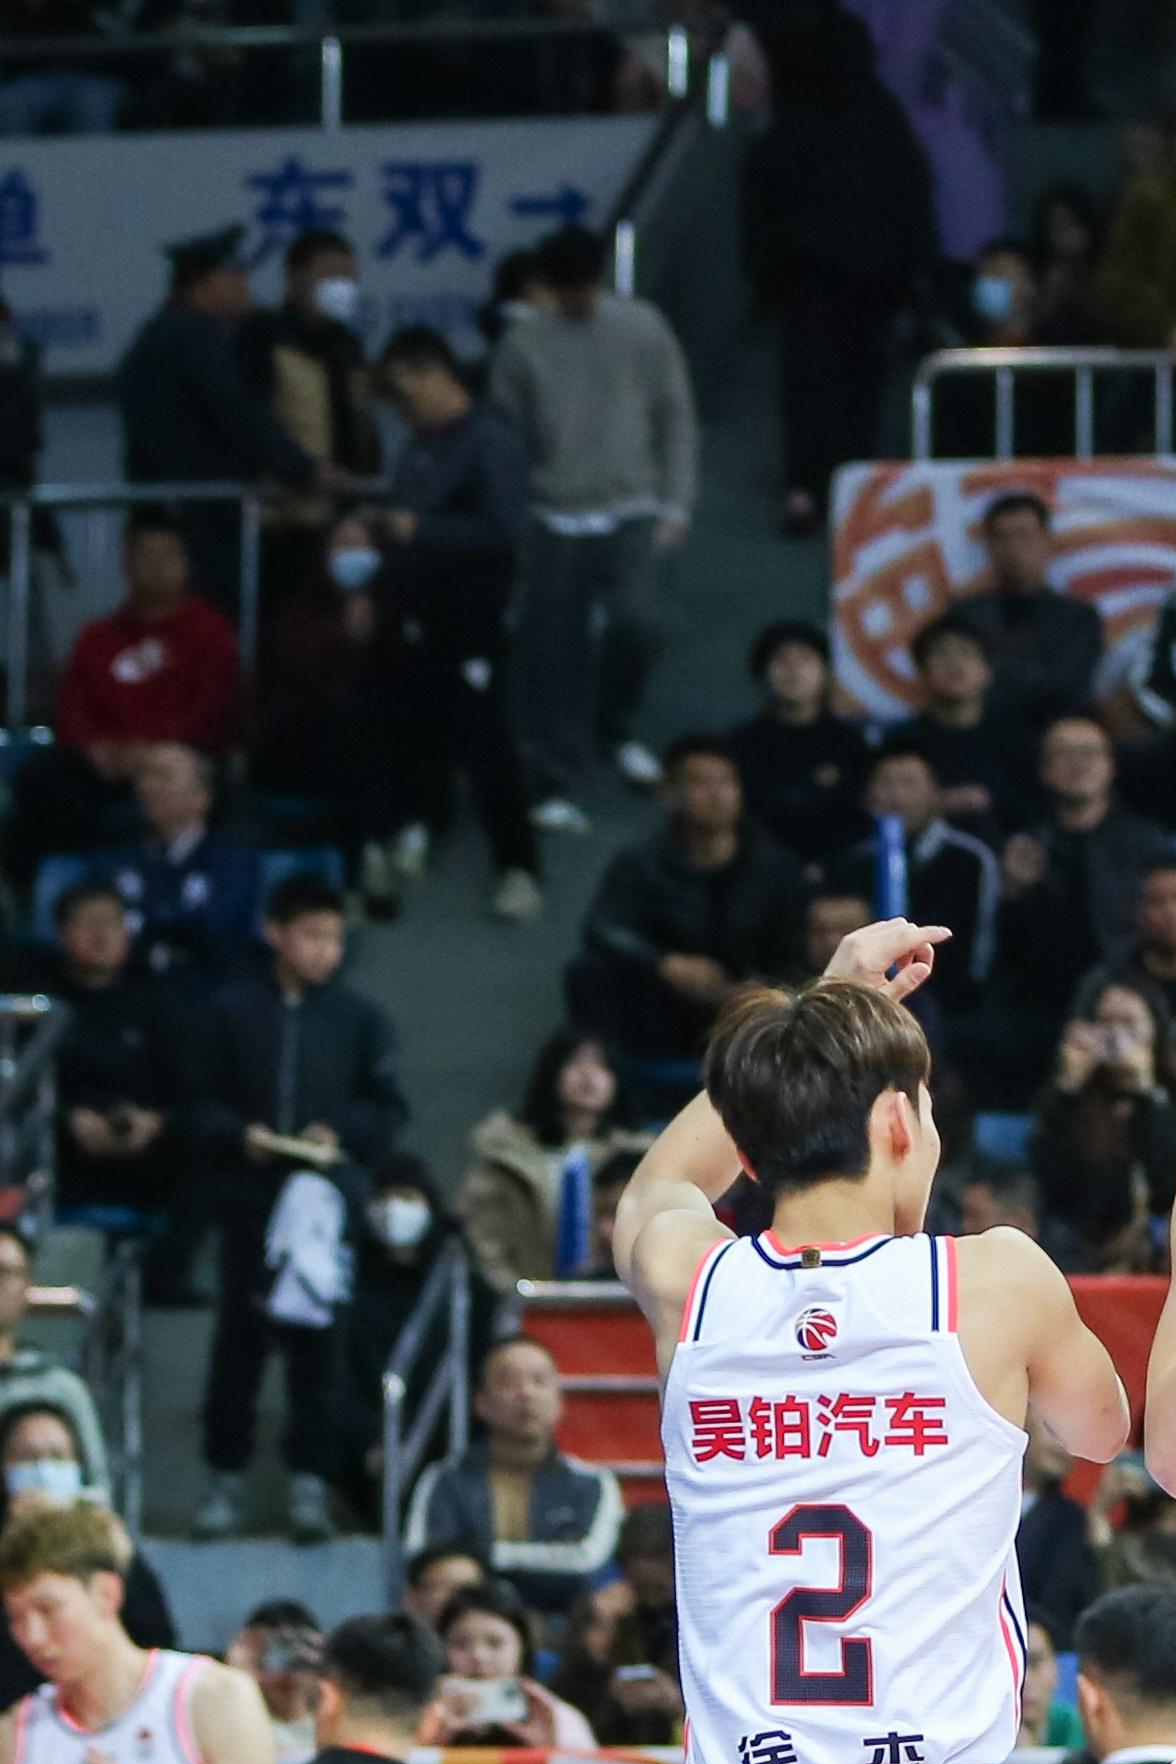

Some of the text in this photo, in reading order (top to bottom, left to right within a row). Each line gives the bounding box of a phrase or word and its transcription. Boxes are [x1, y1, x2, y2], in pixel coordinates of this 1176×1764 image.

[688, 1393, 949, 1462] 昊铂汽车
[769, 1504, 873, 1706] 2
